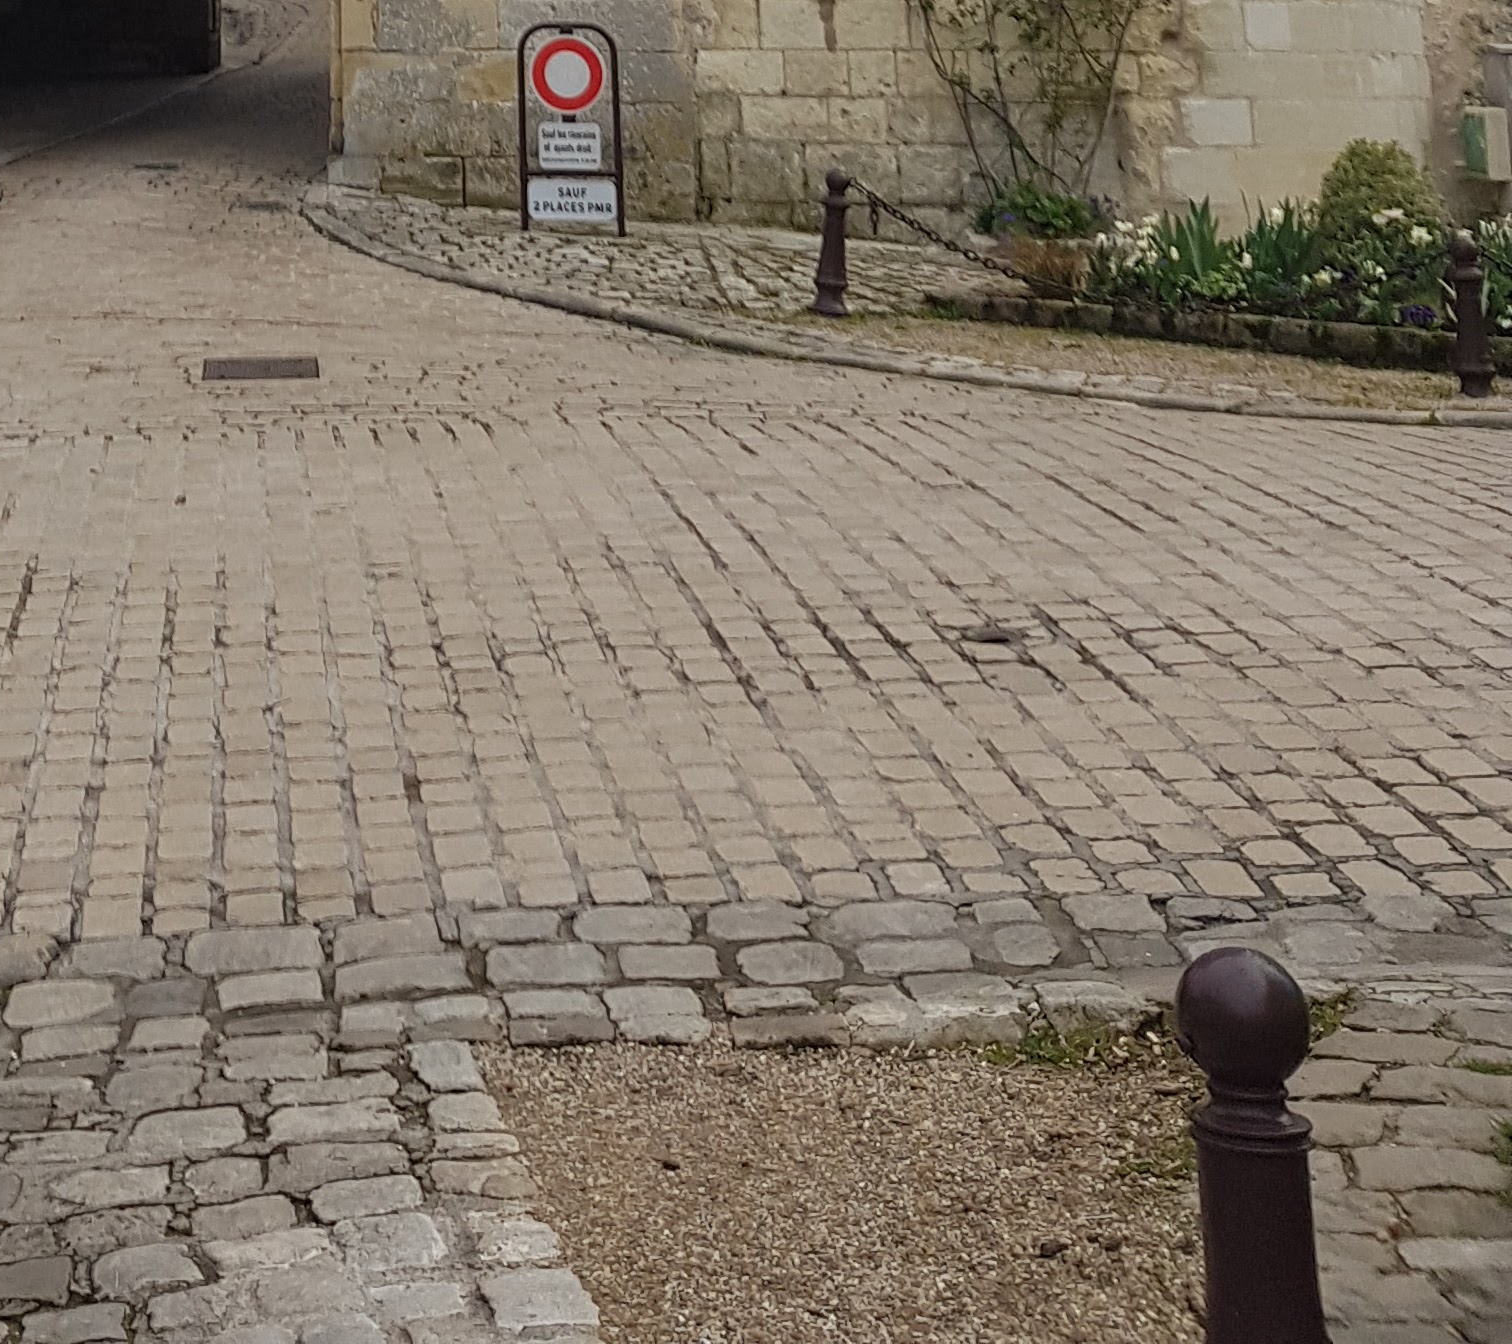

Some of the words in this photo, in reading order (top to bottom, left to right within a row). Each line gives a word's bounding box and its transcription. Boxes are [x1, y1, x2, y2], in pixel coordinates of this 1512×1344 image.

[557, 186, 587, 198] SAUF
[533, 200, 540, 212] 2
[543, 200, 585, 213] PLACES
[587, 201, 613, 214] PMR
